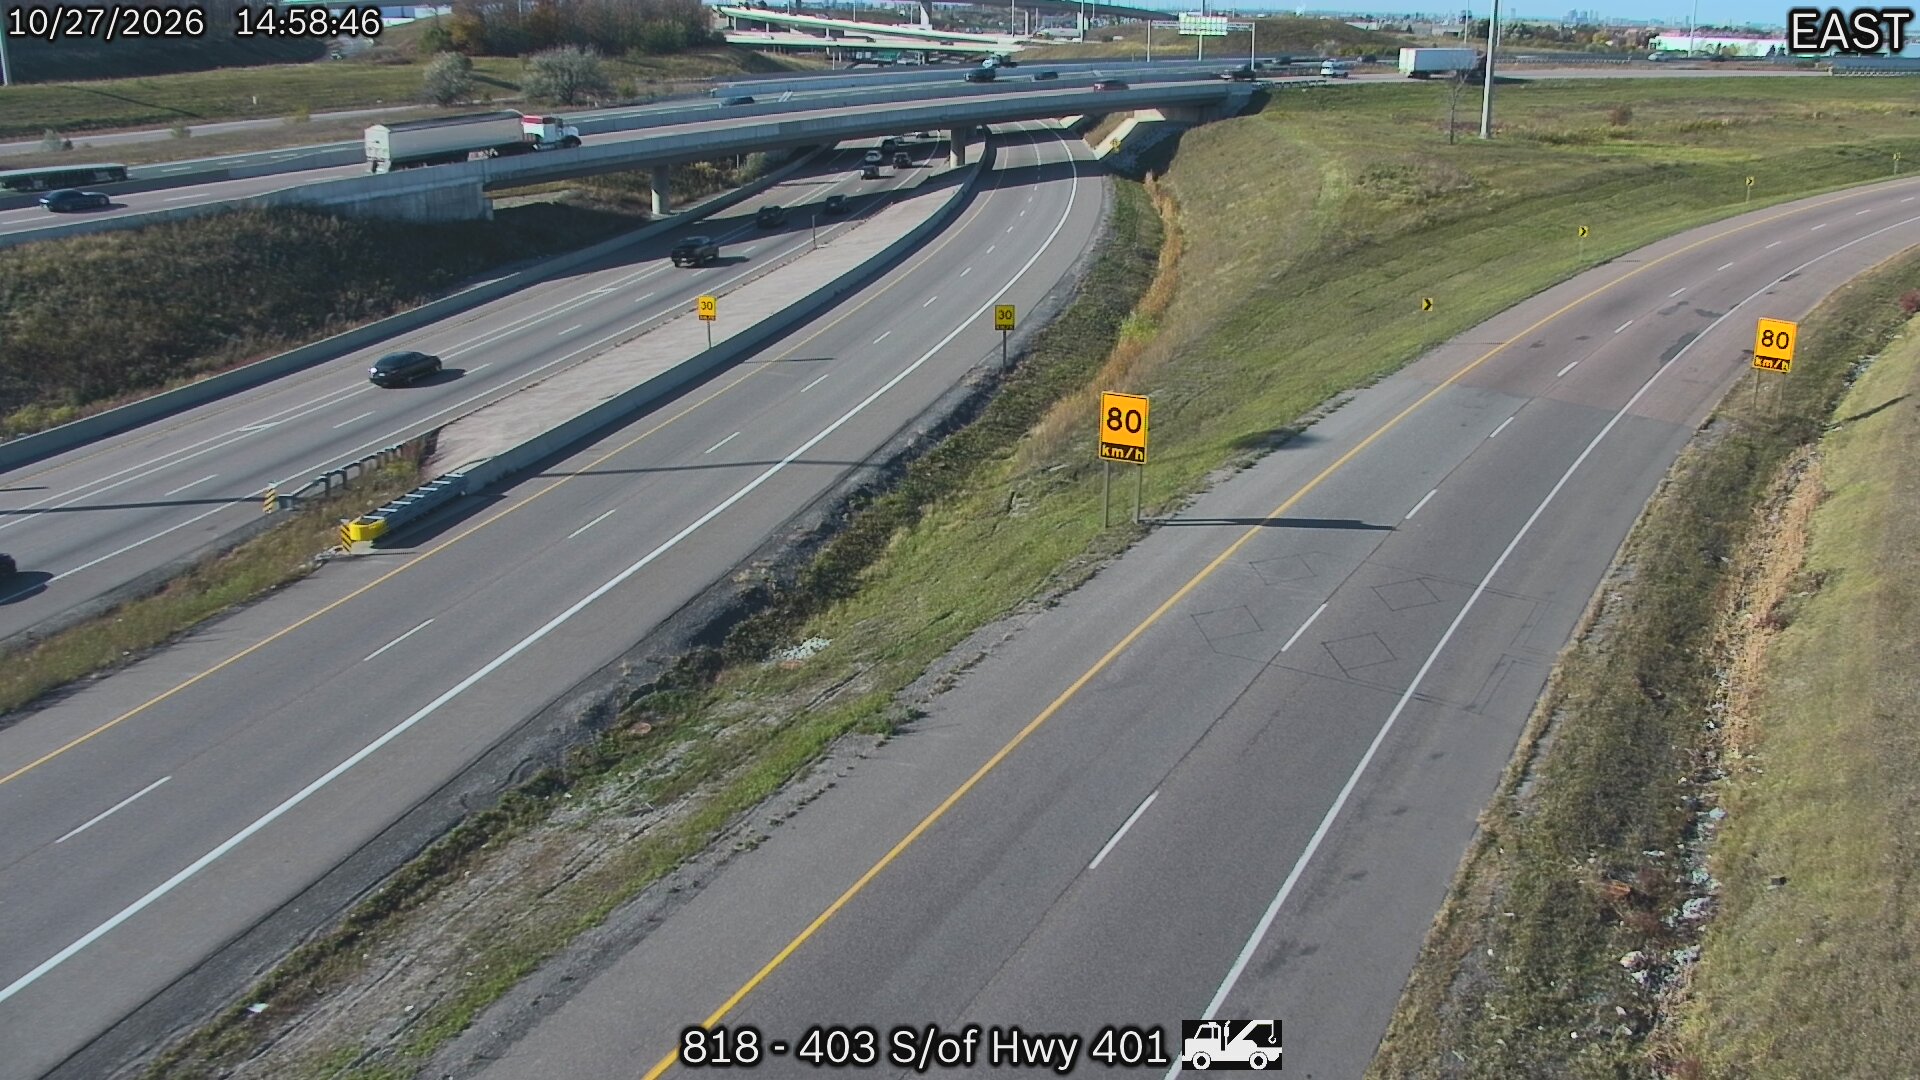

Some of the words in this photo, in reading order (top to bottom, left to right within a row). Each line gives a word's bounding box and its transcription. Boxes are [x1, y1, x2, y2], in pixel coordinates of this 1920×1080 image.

[701, 301, 713, 311] 30
[998, 309, 1012, 320] 30
[1761, 329, 1789, 349] 80
[1107, 407, 1142, 434] 80
[1102, 443, 1144, 461] km/h
